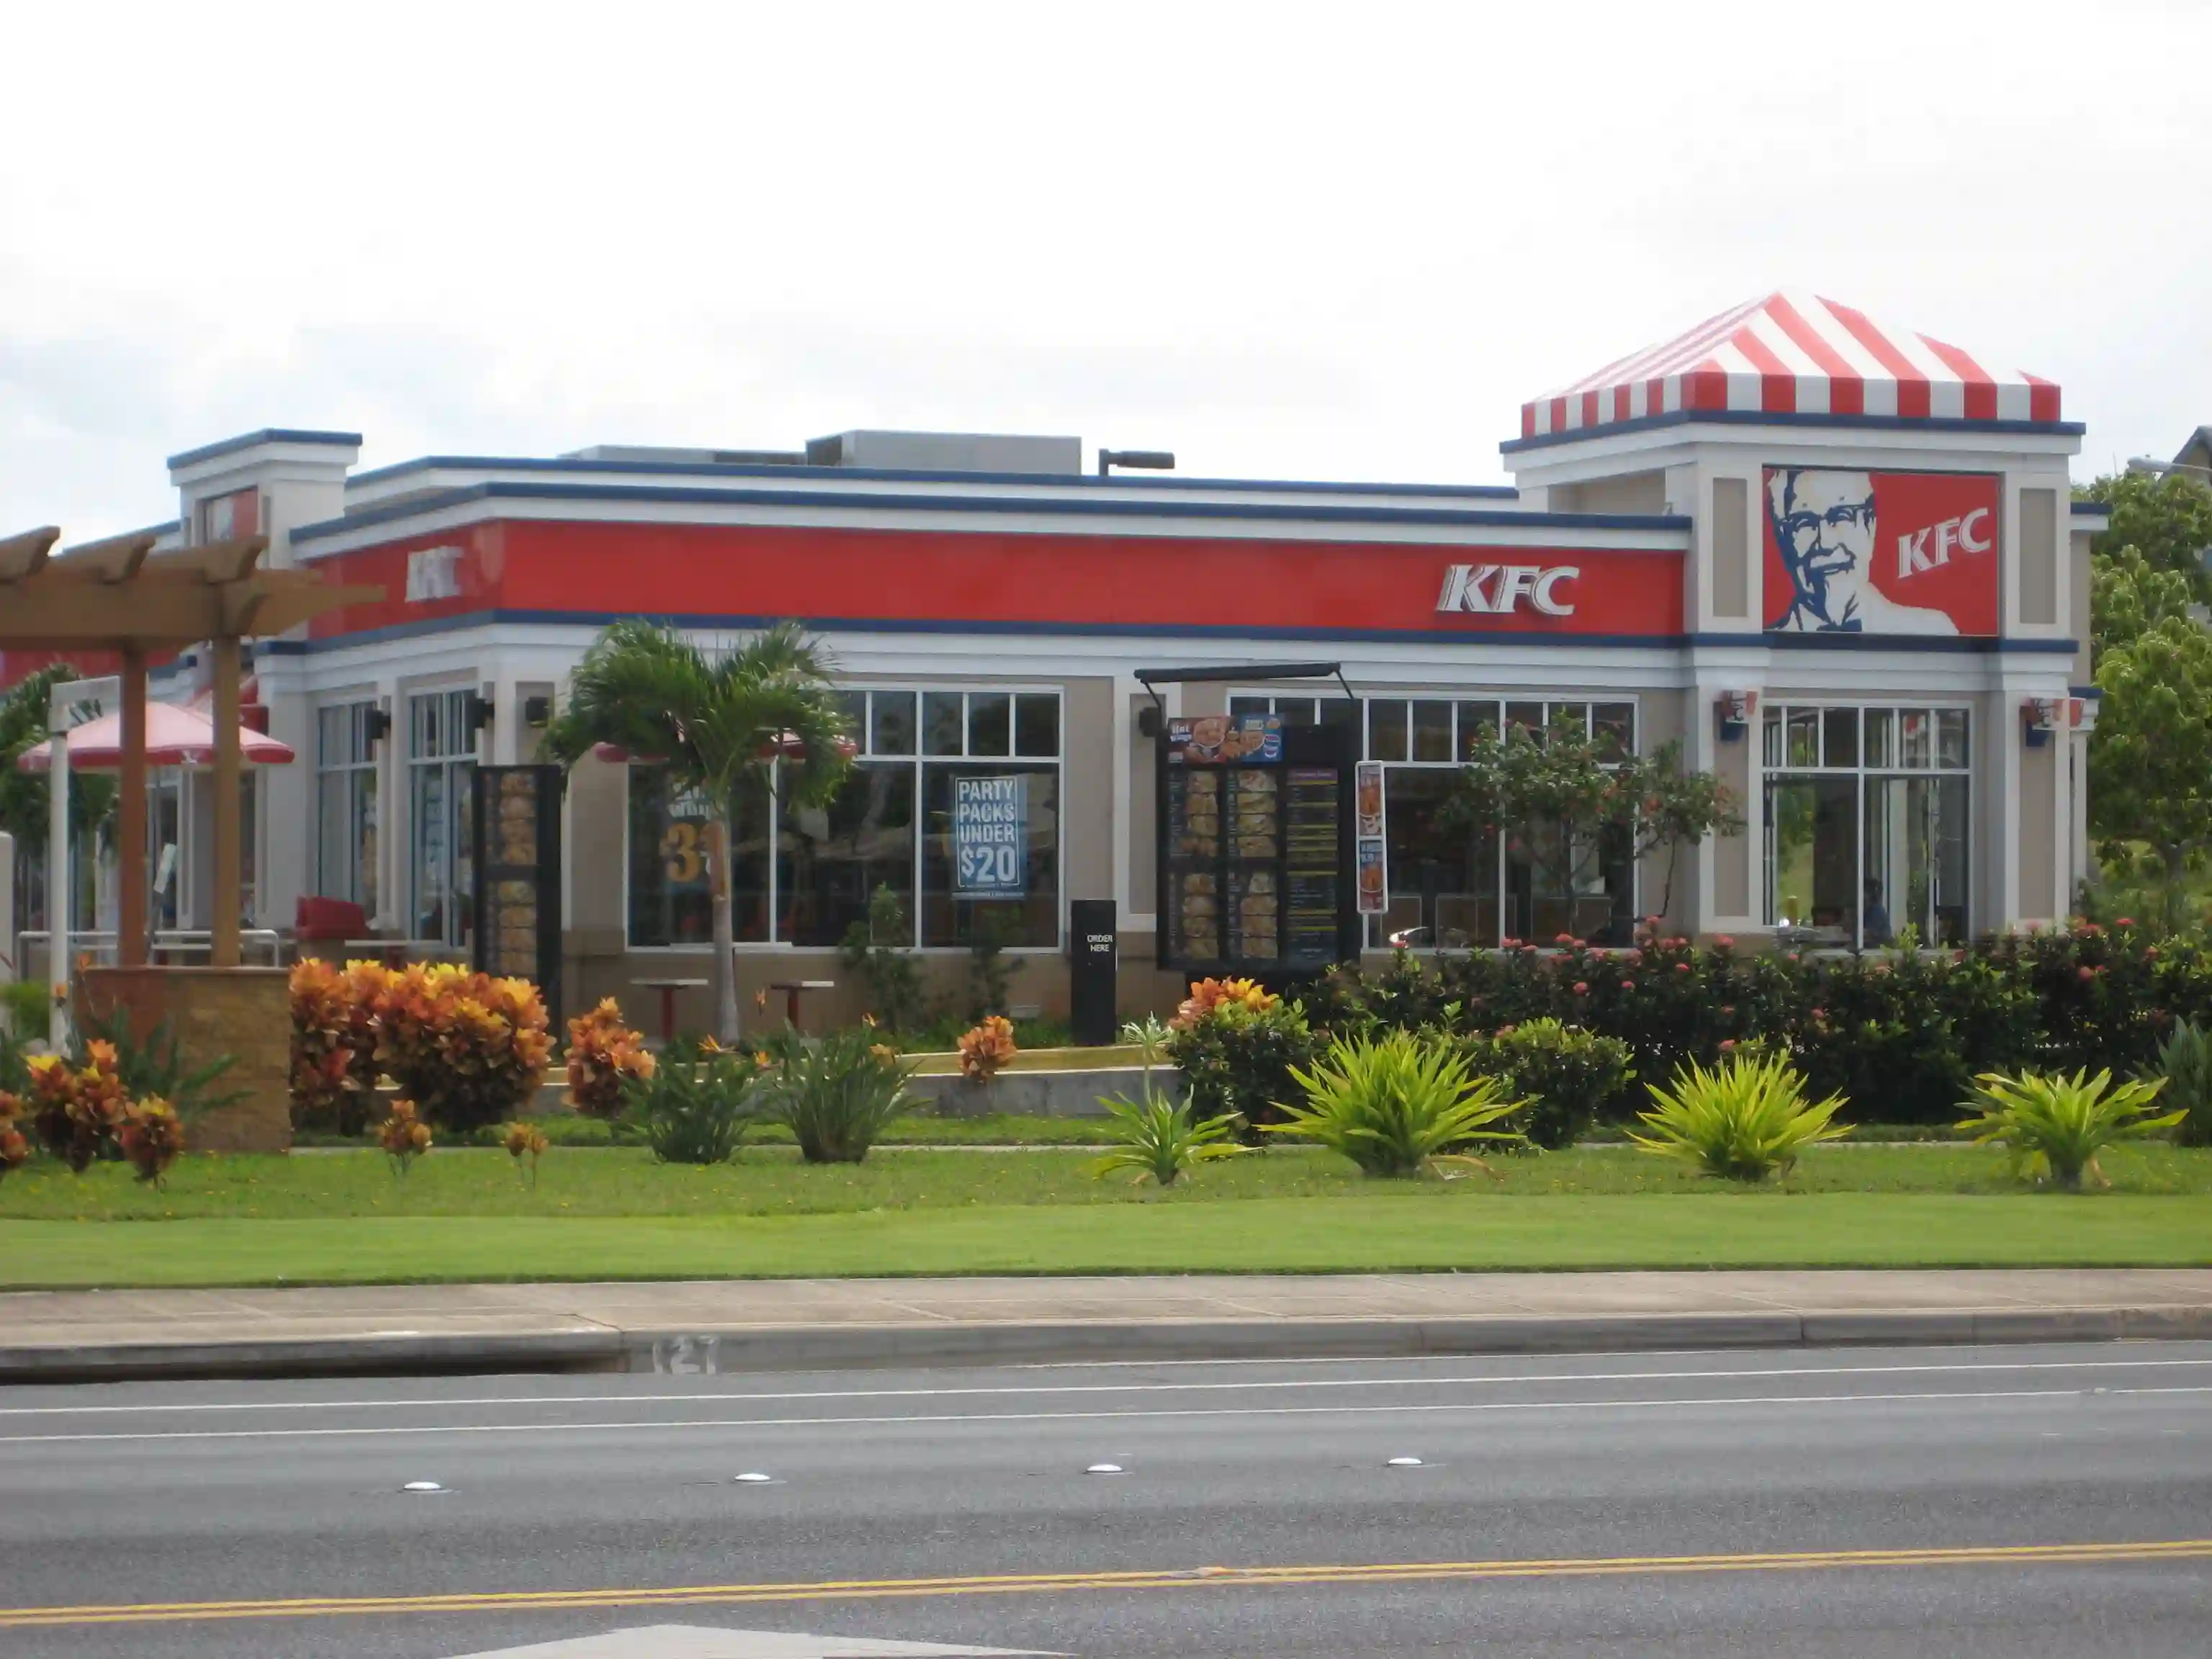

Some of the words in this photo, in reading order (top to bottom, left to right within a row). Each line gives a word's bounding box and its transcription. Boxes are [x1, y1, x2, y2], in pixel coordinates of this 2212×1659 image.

[1897, 508, 1991, 578] KFC
[1436, 565, 1580, 616] KFC
[958, 781, 1014, 801] PARTY
[960, 803, 1015, 823] PACKS
[961, 824, 1015, 842] UNDER
[961, 845, 1016, 883] $20
